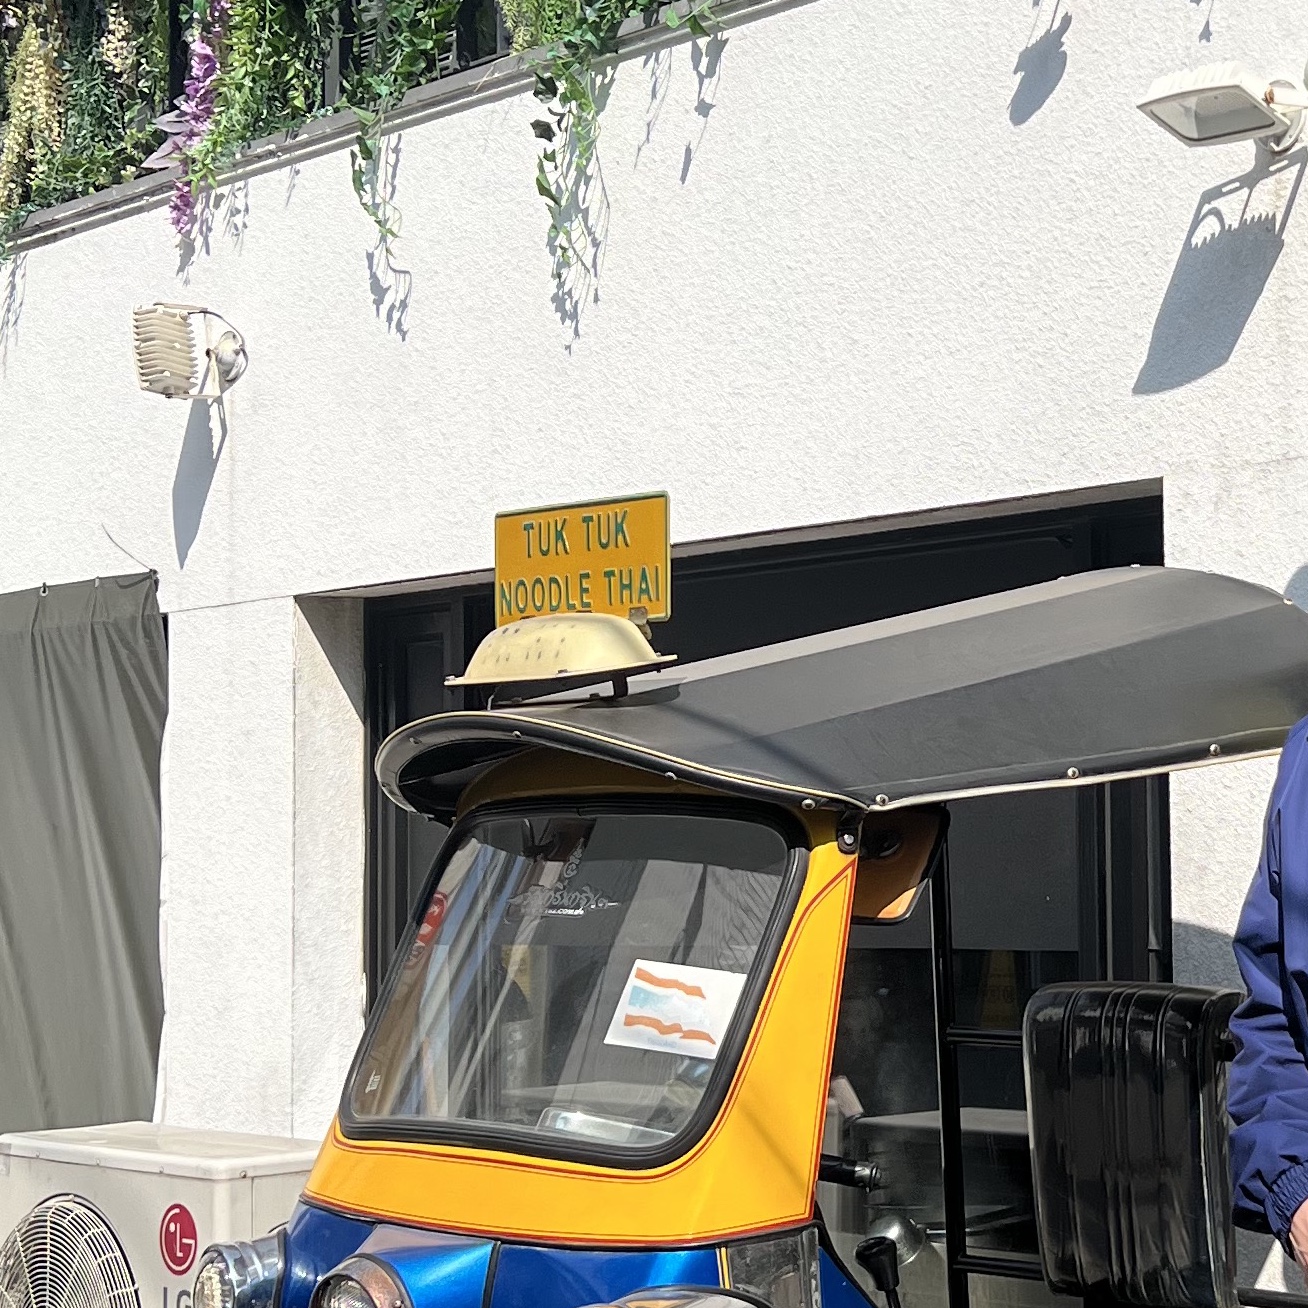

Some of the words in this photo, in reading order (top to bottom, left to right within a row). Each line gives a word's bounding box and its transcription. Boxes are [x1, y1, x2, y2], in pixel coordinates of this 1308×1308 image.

[523, 516, 570, 558] TUK
[582, 508, 631, 551] TUK
[500, 571, 593, 616] NOODLE
[603, 564, 660, 606] THAI
